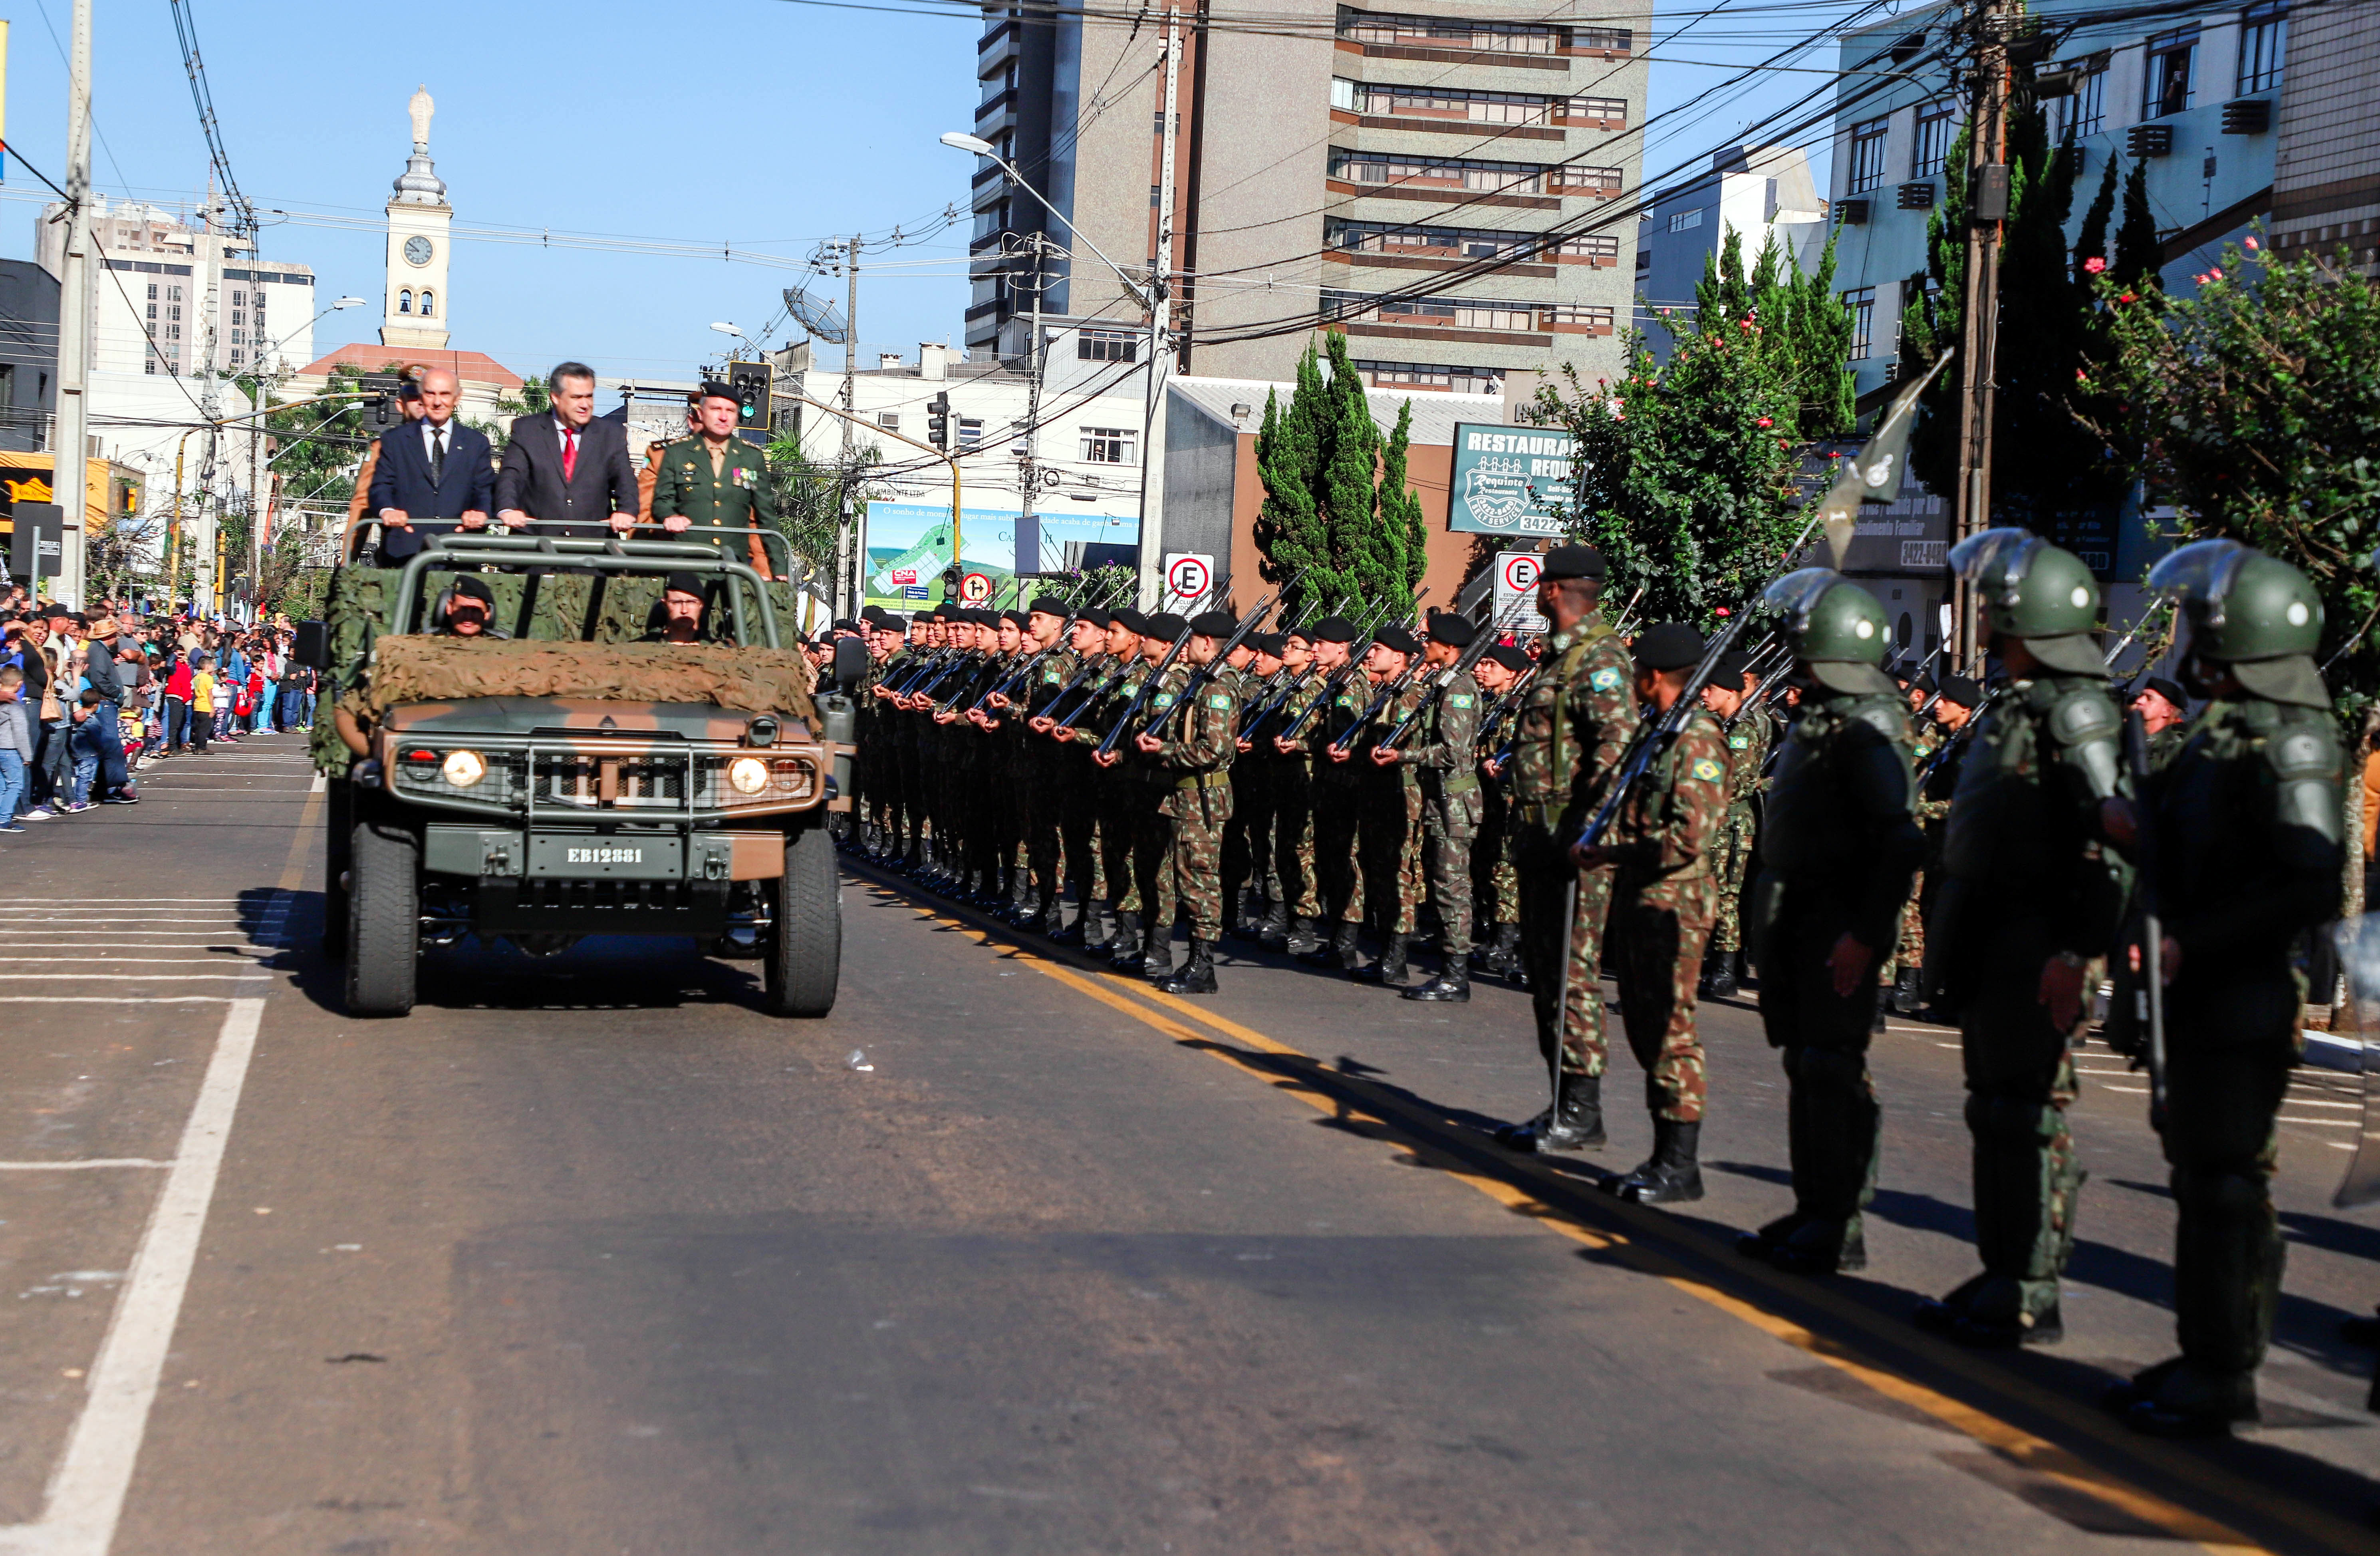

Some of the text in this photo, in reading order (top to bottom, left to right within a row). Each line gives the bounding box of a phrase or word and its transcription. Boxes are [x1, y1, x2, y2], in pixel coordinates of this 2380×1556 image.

[1468, 432, 1584, 458] RESTAURAN
[1531, 459, 1574, 480] REQUI
[1474, 474, 1524, 488] Requinte
[910, 489, 925, 498] LTDA
[1478, 486, 1518, 495] Restaurante
[1472, 504, 1521, 525] SELF SERVICE
[1480, 499, 1514, 515] 3422-8480
[961, 511, 979, 521] lugar
[1092, 519, 1114, 528] ganha
[1182, 567, 1197, 589] E
[1517, 566, 1529, 583] E
[567, 848, 642, 863] EB12881
